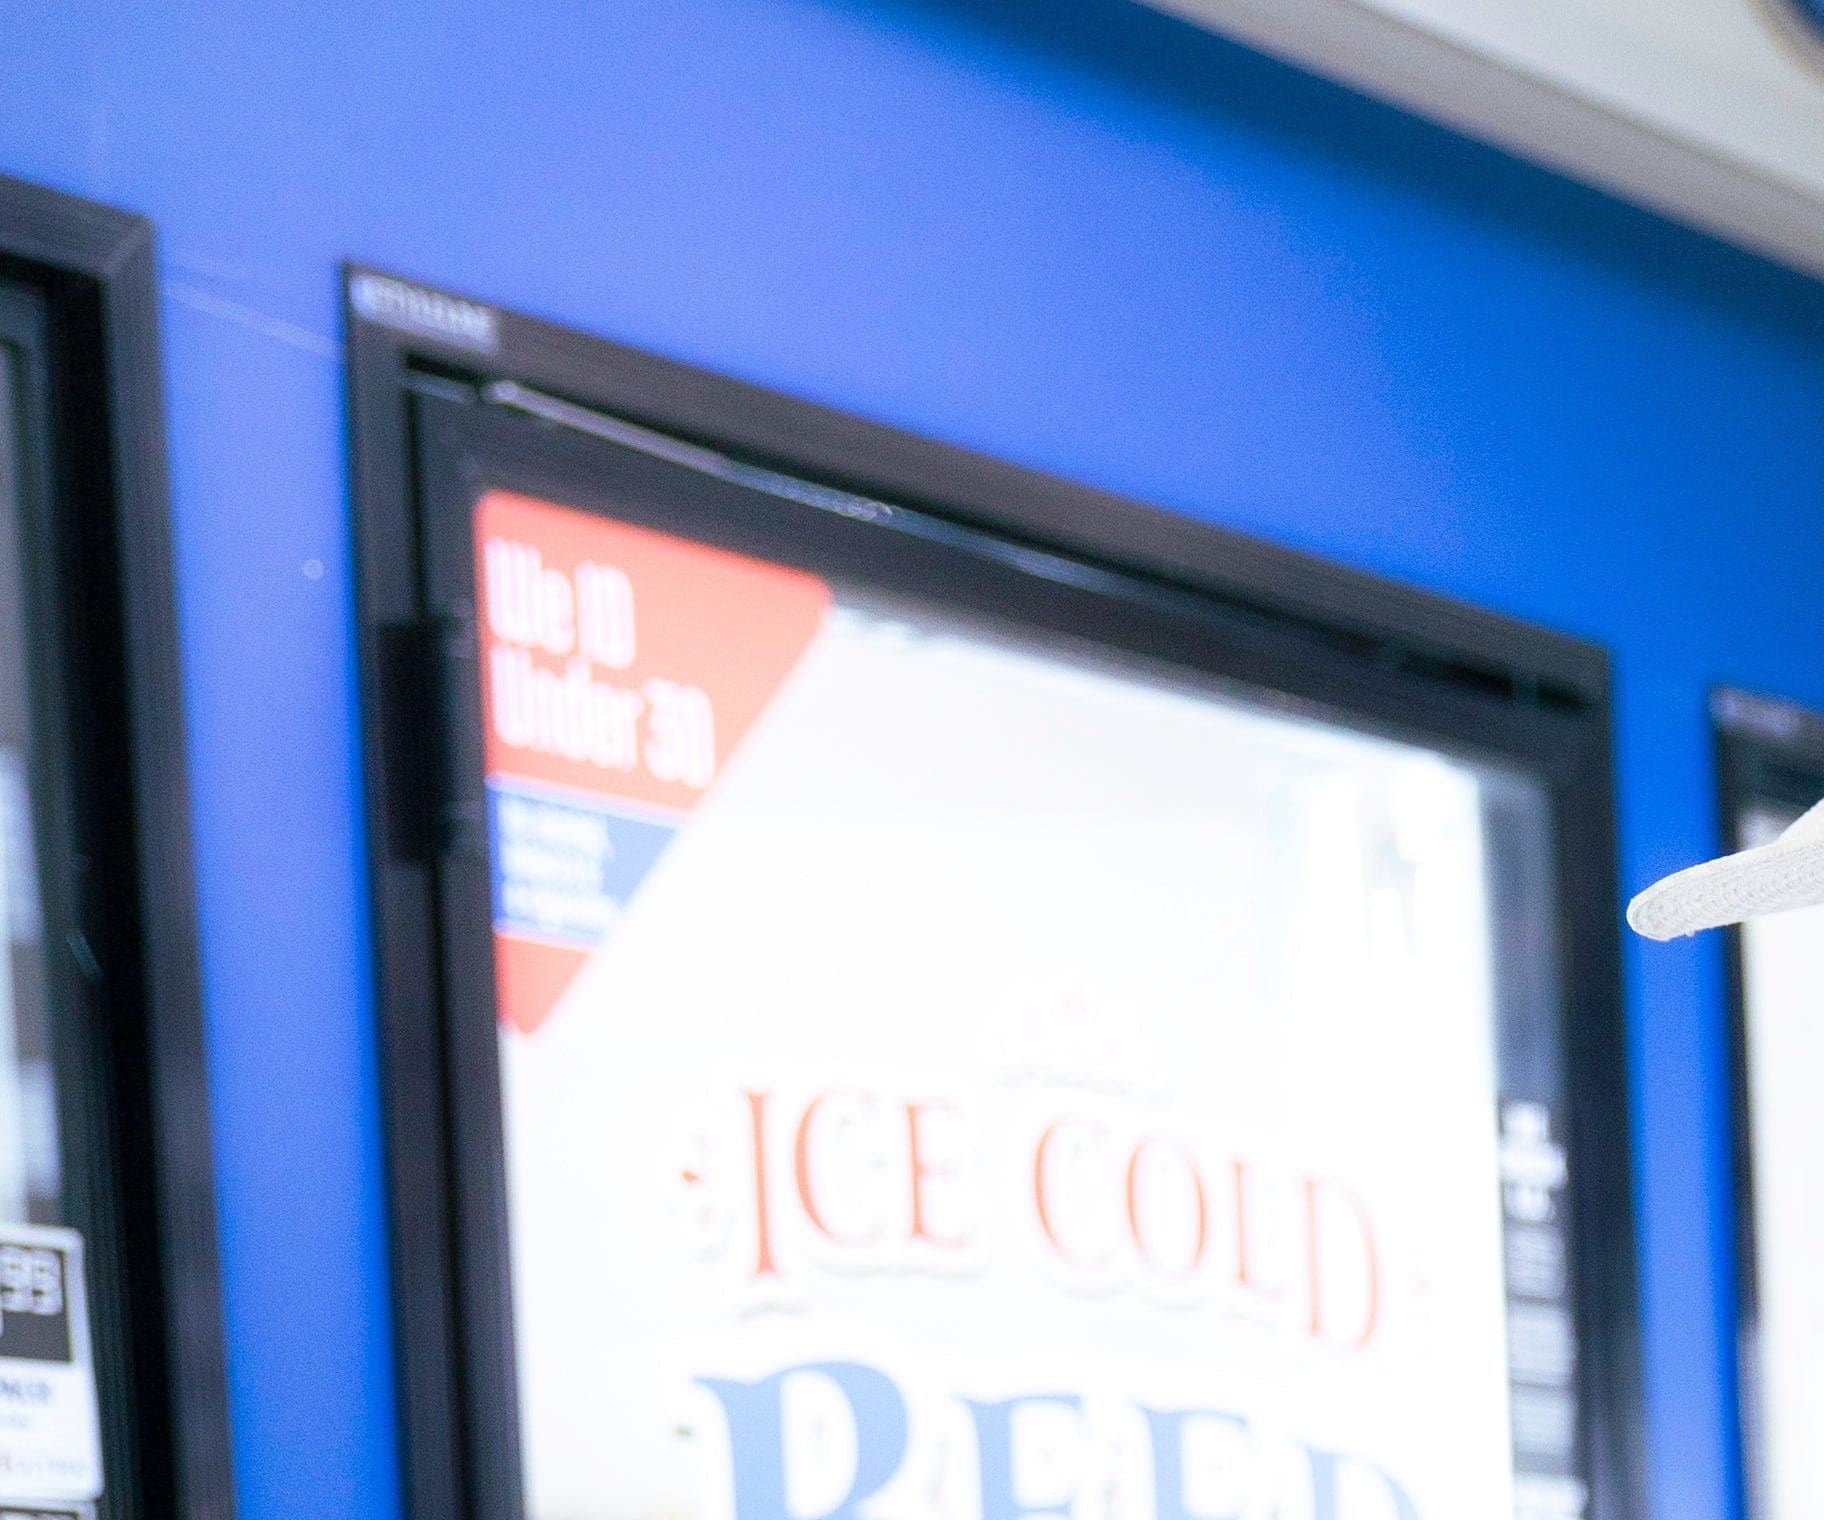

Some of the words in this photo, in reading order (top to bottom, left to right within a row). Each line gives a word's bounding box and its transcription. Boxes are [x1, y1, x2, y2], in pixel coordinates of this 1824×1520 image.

[485, 537, 575, 656] We
[575, 560, 636, 671] ID
[491, 646, 645, 774] Under
[642, 677, 716, 790] 30
[741, 1090, 970, 1278] ICE
[1032, 1116, 1386, 1353] COLD
